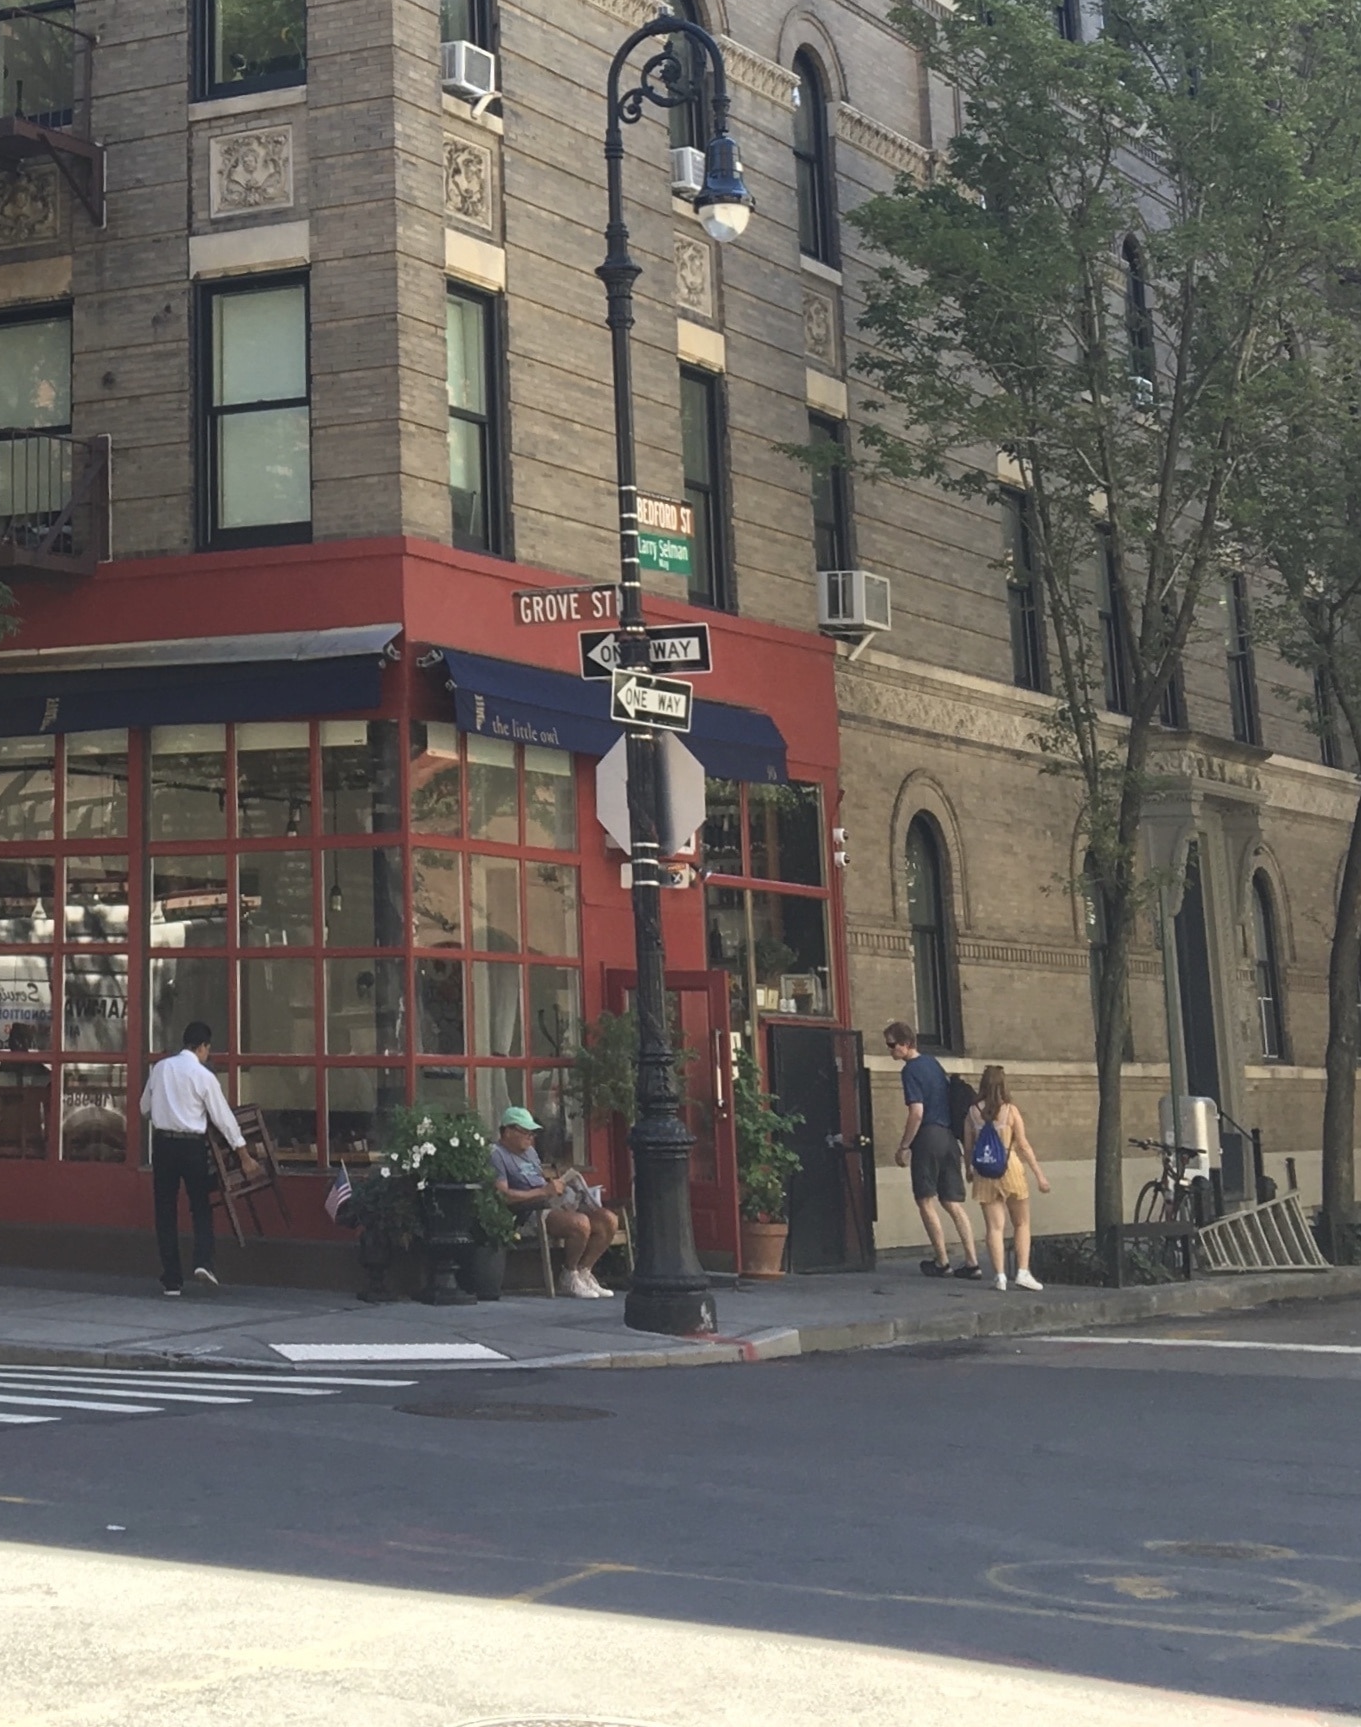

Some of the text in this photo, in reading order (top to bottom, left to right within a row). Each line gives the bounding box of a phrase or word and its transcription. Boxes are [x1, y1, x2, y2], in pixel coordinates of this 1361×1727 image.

[636, 496, 678, 531] BEDFORD
[680, 507, 691, 534] ST
[637, 536, 689, 562] Larry Selman
[520, 591, 612, 623] GROVE ST
[600, 640, 691, 663] ON WAY
[625, 687, 682, 713] ONE WAY
[492, 715, 560, 745] the little owl
